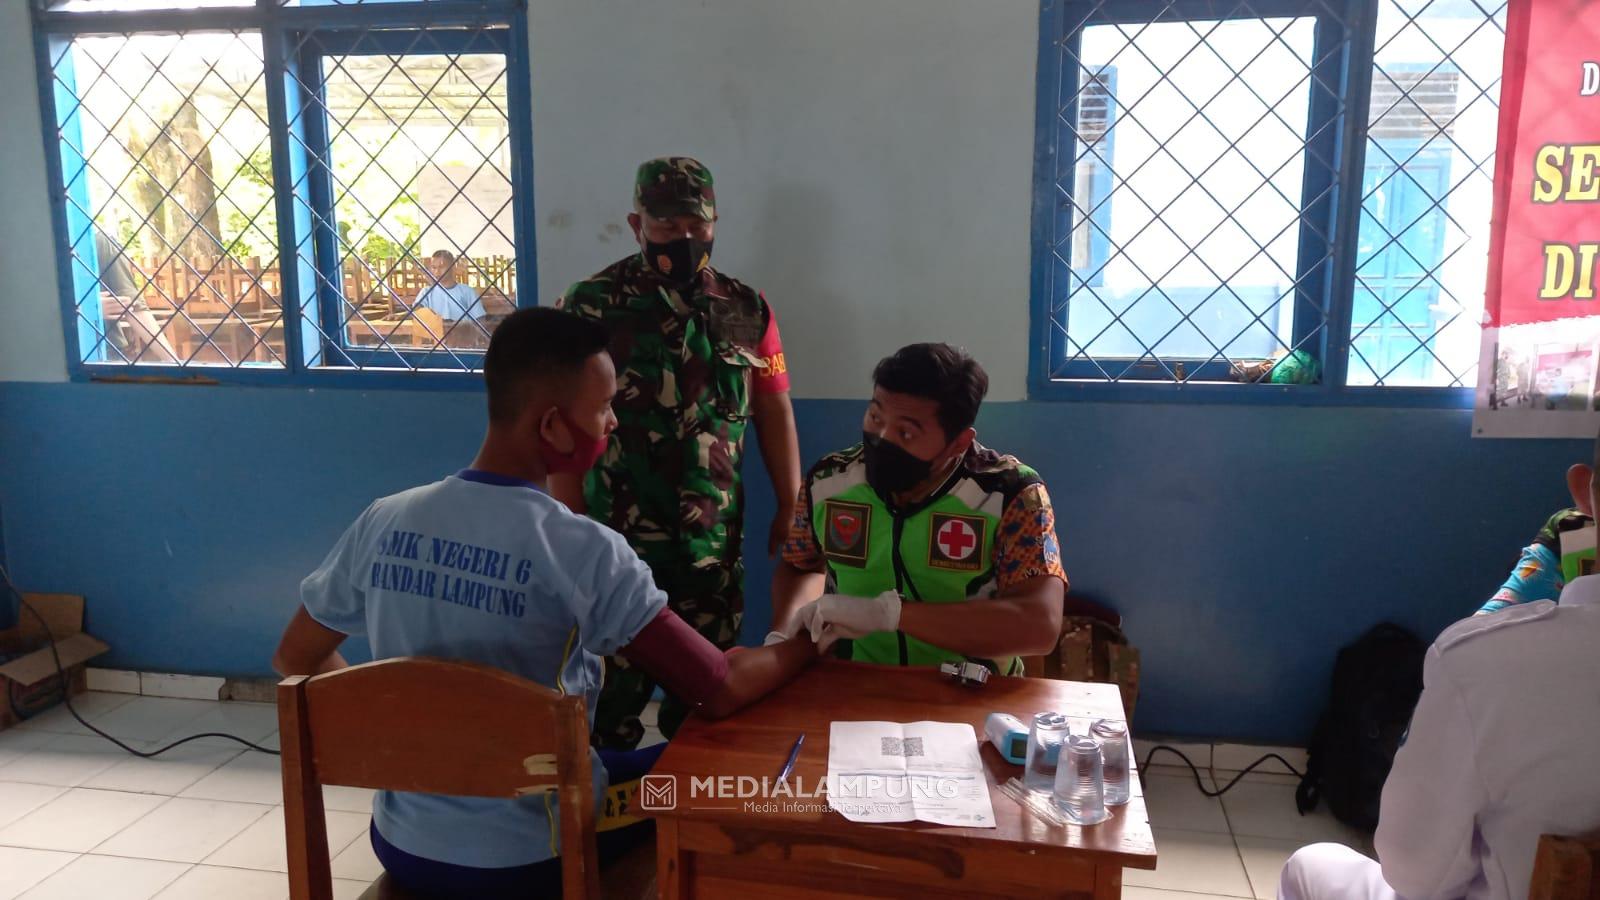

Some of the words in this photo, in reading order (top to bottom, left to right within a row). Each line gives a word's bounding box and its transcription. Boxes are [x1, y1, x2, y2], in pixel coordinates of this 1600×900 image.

[1540, 244, 1599, 298] DI
[425, 537, 511, 581] NEGERI
[515, 558, 533, 585] 6
[371, 561, 437, 599] BANDAR
[441, 573, 527, 619] LAMPUNG
